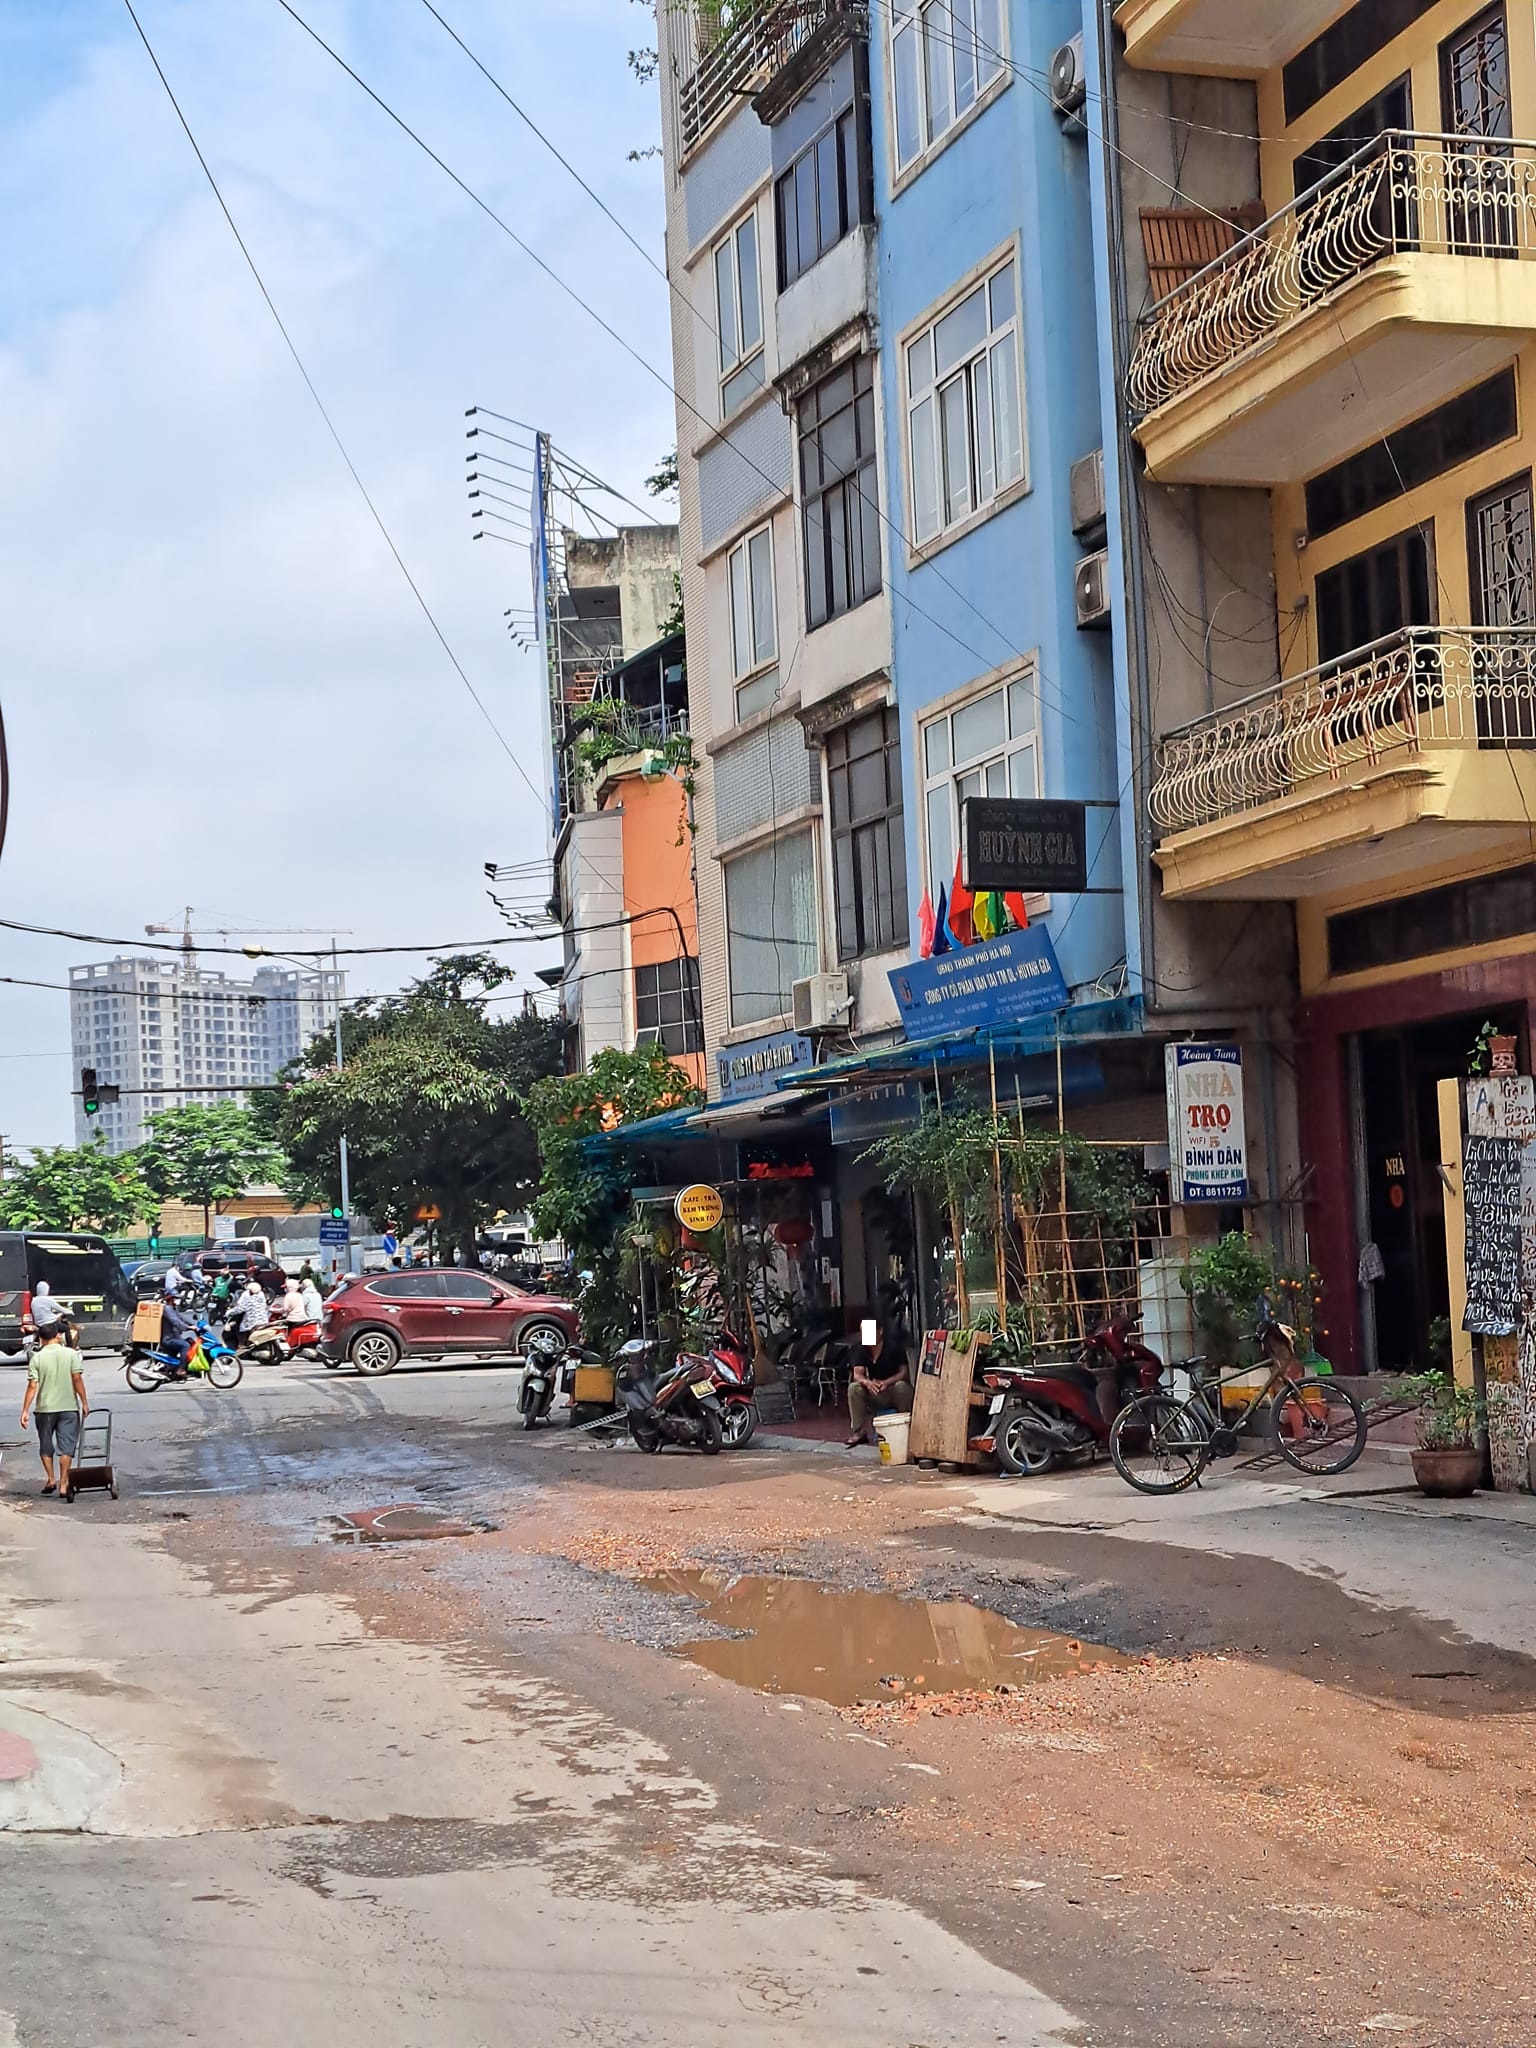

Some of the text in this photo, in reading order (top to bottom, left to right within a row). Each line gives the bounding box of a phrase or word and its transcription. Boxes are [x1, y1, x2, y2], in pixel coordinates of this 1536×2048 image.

[978, 824, 1077, 865] HUỲNH GIA
[941, 986, 951, 1002] TY
[1039, 957, 1053, 975] GIA
[1185, 1064, 1236, 1098] NHÀ
[1187, 1103, 1231, 1133] TRỌ
[1185, 1145, 1242, 1166] BÌNH DÂN
